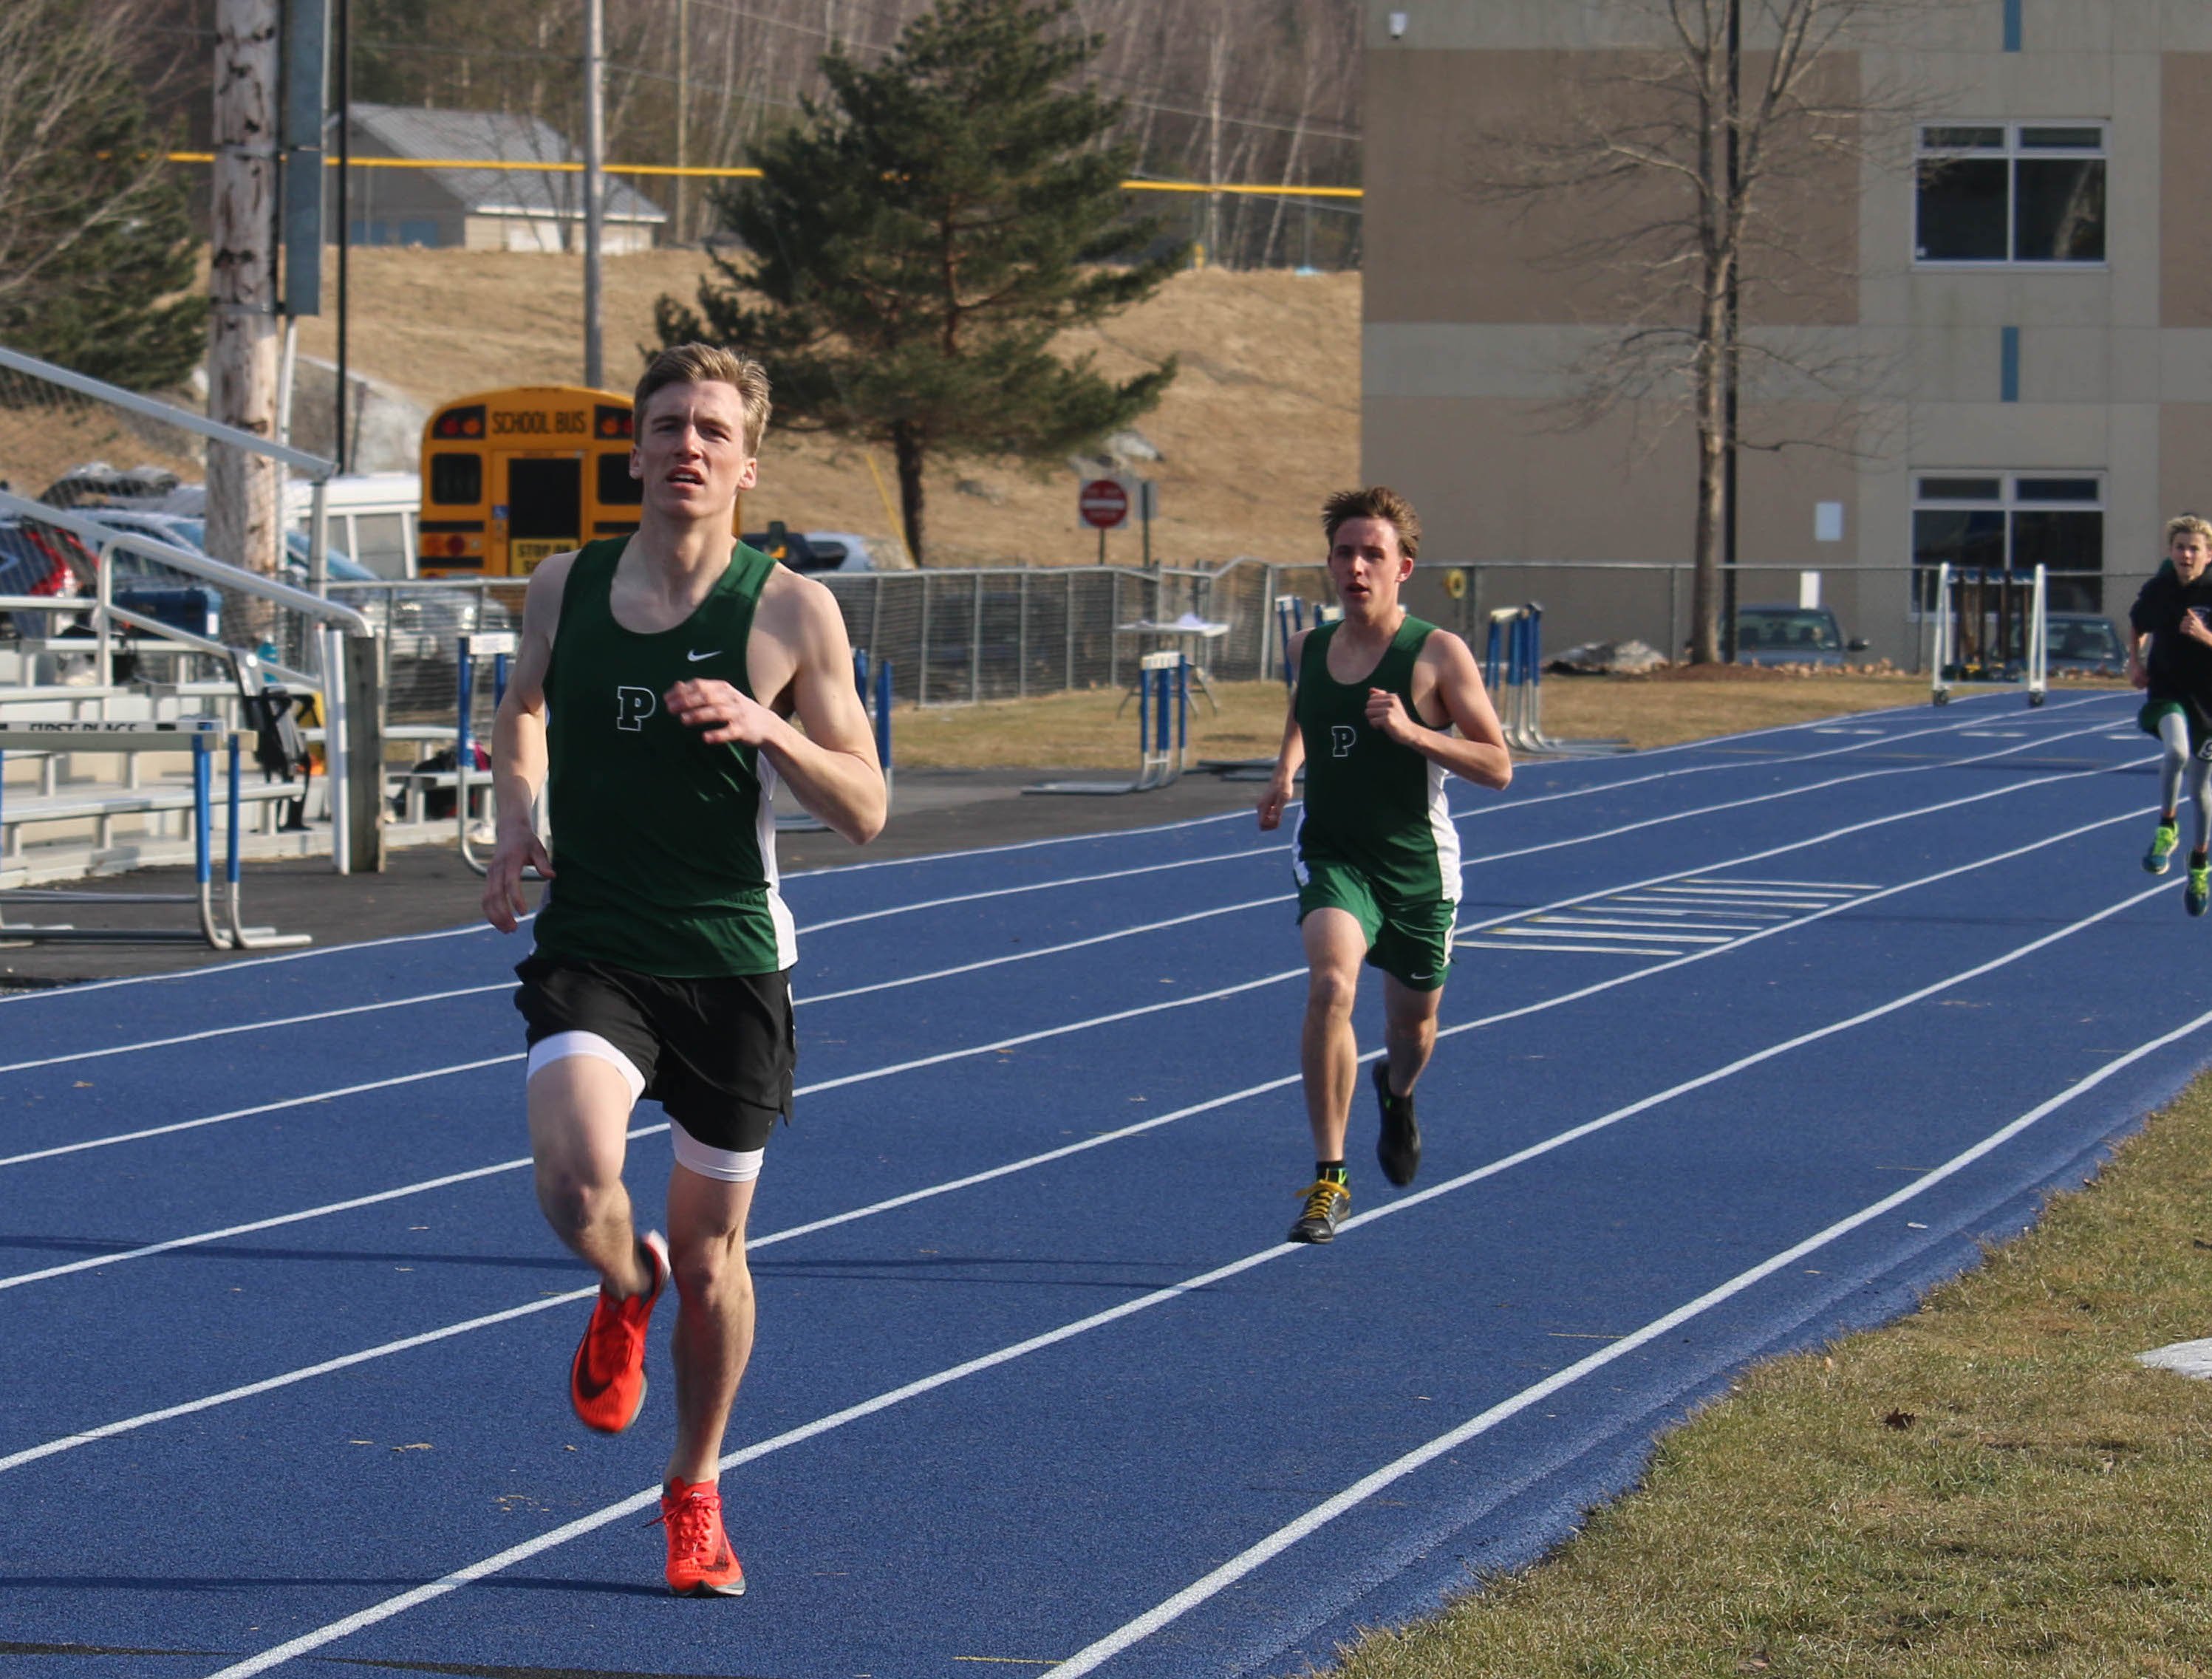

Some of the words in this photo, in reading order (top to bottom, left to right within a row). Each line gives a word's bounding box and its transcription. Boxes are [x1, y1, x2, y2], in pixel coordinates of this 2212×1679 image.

[492, 411, 550, 434] SCHOOL
[556, 411, 586, 434] BUS
[617, 685, 656, 731] P
[1331, 725, 1356, 757] P
